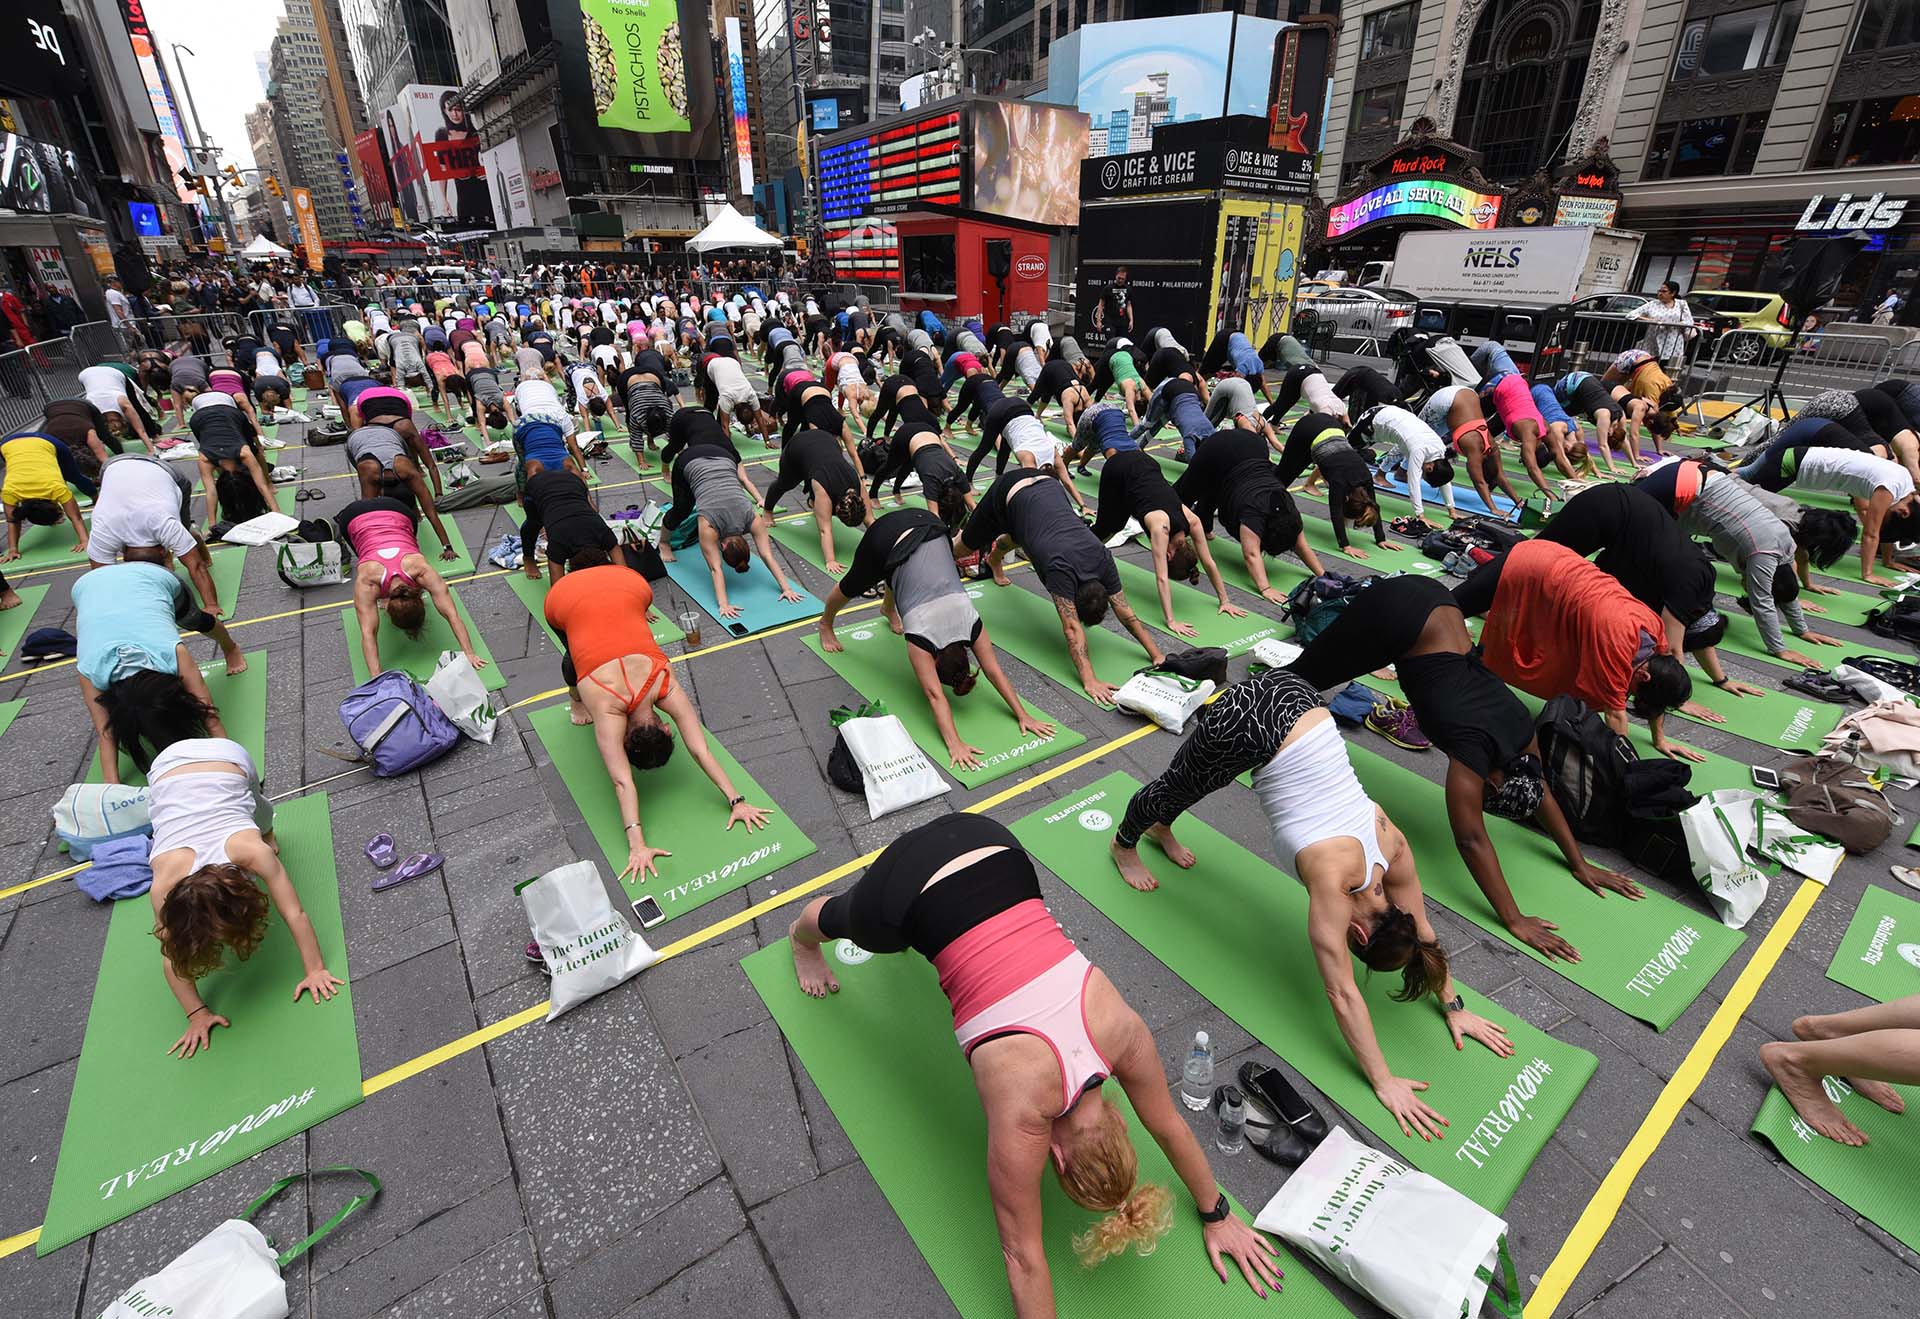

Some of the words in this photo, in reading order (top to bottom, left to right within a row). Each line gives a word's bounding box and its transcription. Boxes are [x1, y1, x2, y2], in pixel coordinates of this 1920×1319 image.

[612, 7, 623, 15] No
[625, 8, 647, 17] Shells
[625, 23, 651, 121] PISTACHIOS
[1124, 158, 1145, 177] ICE
[1149, 156, 1159, 174] &
[1163, 151, 1196, 172] VICE
[1239, 151, 1253, 165] ICE
[1254, 153, 1260, 166] &
[1262, 153, 1279, 168] VICE
[1301, 160, 1312, 172] 5%
[1391, 156, 1419, 174] Hard
[1418, 153, 1447, 174] Rock
[1122, 177, 1147, 189] CRAFT
[1149, 175, 1162, 186] ICE
[1165, 172, 1194, 184] CREAM
[1238, 165, 1253, 174] CRAFT
[1262, 168, 1277, 177] CREAM
[874, 205, 887, 214] STRAND
[896, 204, 908, 212] STORE
[1352, 194, 1383, 222] LOVE
[1383, 188, 1404, 206] ALL
[1408, 187, 1445, 206] SERVE
[1444, 194, 1466, 217] ALL
[1560, 200, 1574, 208] OPEN
[1574, 201, 1585, 209] FOR
[1585, 202, 1616, 211] BREAKFAST
[1794, 192, 1909, 231] Lids
[33, 248, 62, 262] ATM
[1464, 247, 1522, 268] NELS
[1596, 256, 1620, 271] NELS
[40, 267, 68, 281] Drink
[1018, 263, 1045, 271] STRAND
[1162, 281, 1203, 289] PHILANTHROPY
[1085, 332, 1094, 340] ICE
[864, 762, 883, 776] The
[883, 752, 916, 772] future
[111, 795, 146, 812] Love
[664, 842, 782, 902] #aerieREAL
[551, 943, 574, 960] The
[577, 920, 620, 948] future
[555, 931, 632, 976] #AerieRE
[1626, 925, 1701, 998] #aerieREAL
[1455, 1057, 1553, 1169] #aerieREAL
[100, 1087, 316, 1200] #aerieREAL
[1382, 1159, 1411, 1178] The
[1308, 1150, 1381, 1232] #AerieREAL
[1341, 1178, 1386, 1232] future
[1328, 1233, 1350, 1255] is
